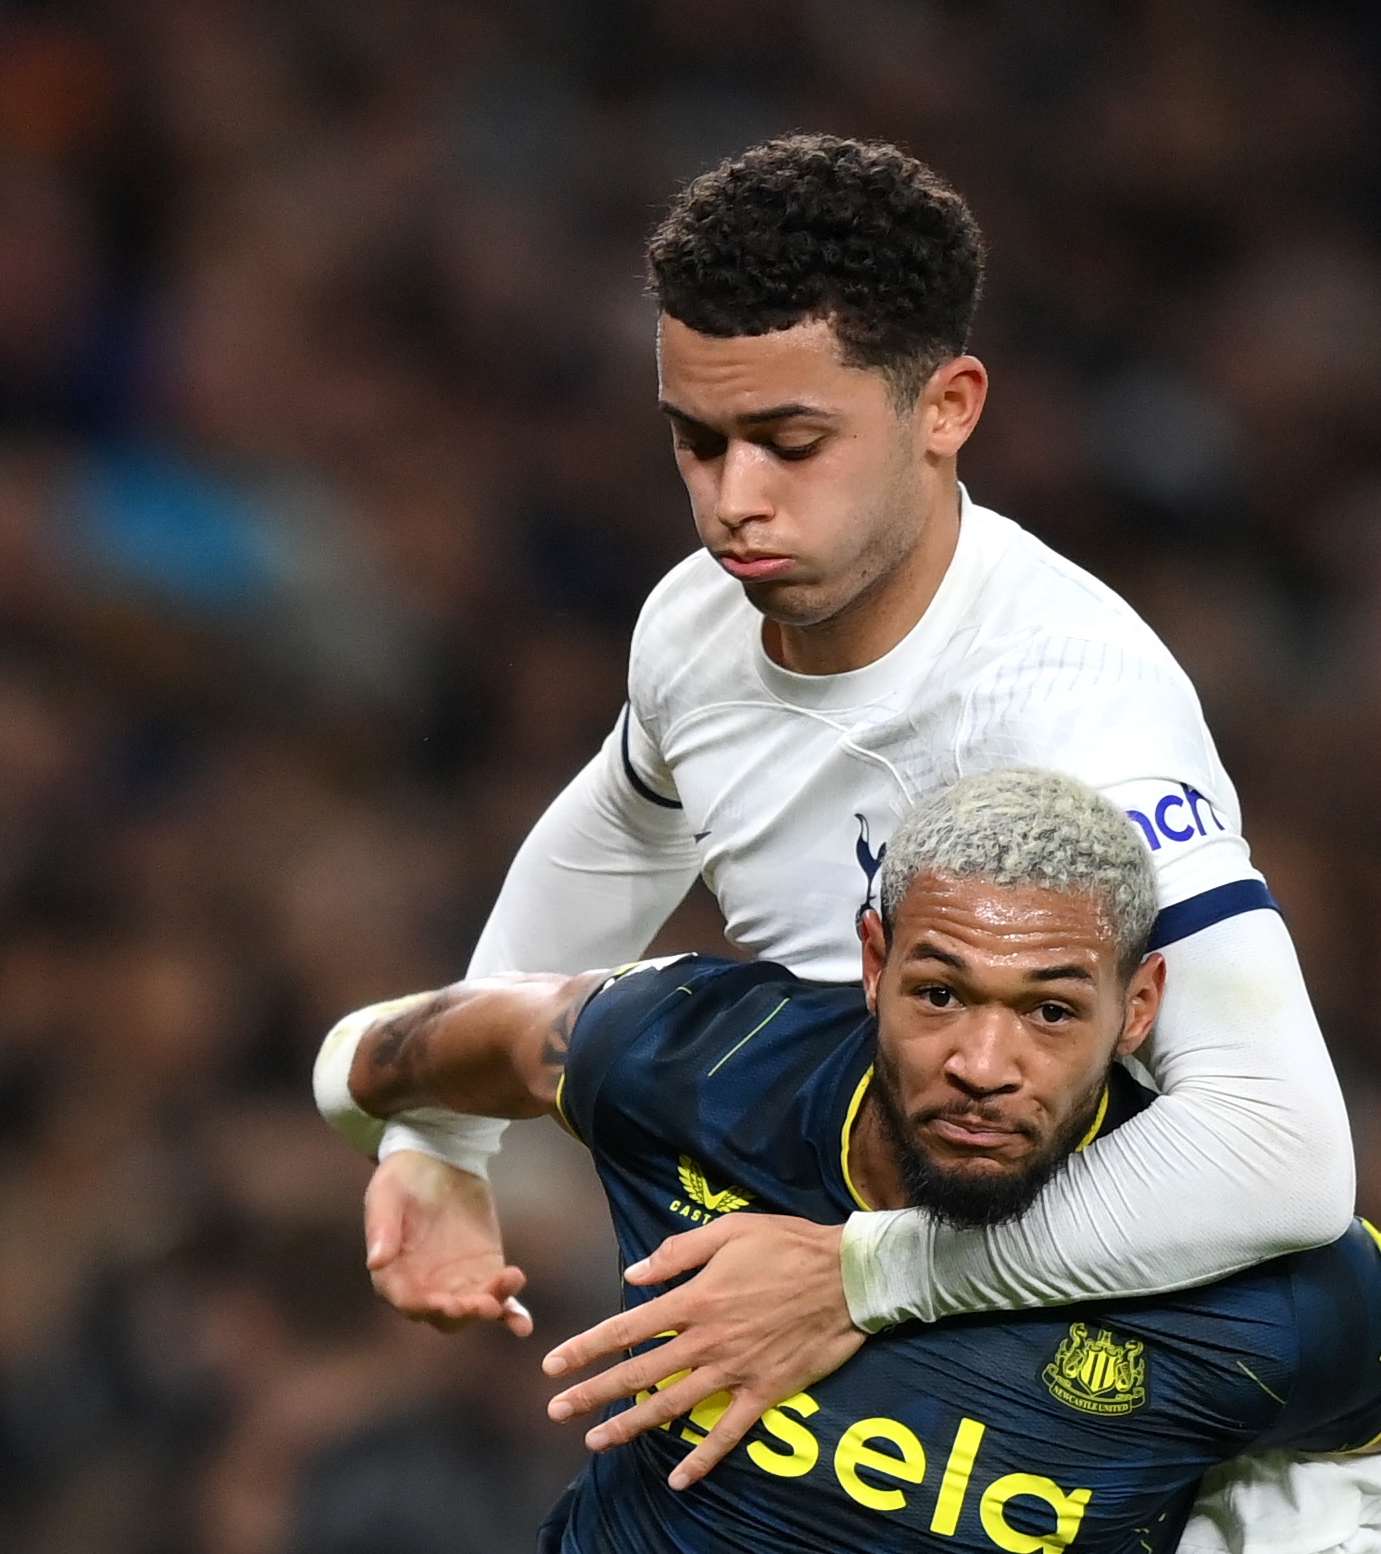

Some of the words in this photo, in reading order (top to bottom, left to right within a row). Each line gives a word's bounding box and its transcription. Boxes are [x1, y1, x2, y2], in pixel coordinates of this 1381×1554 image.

[669, 1200, 712, 1226] CAST
[1052, 1385, 1098, 1411] NEWCASTLE
[1098, 1403, 1129, 1413] UNITED
